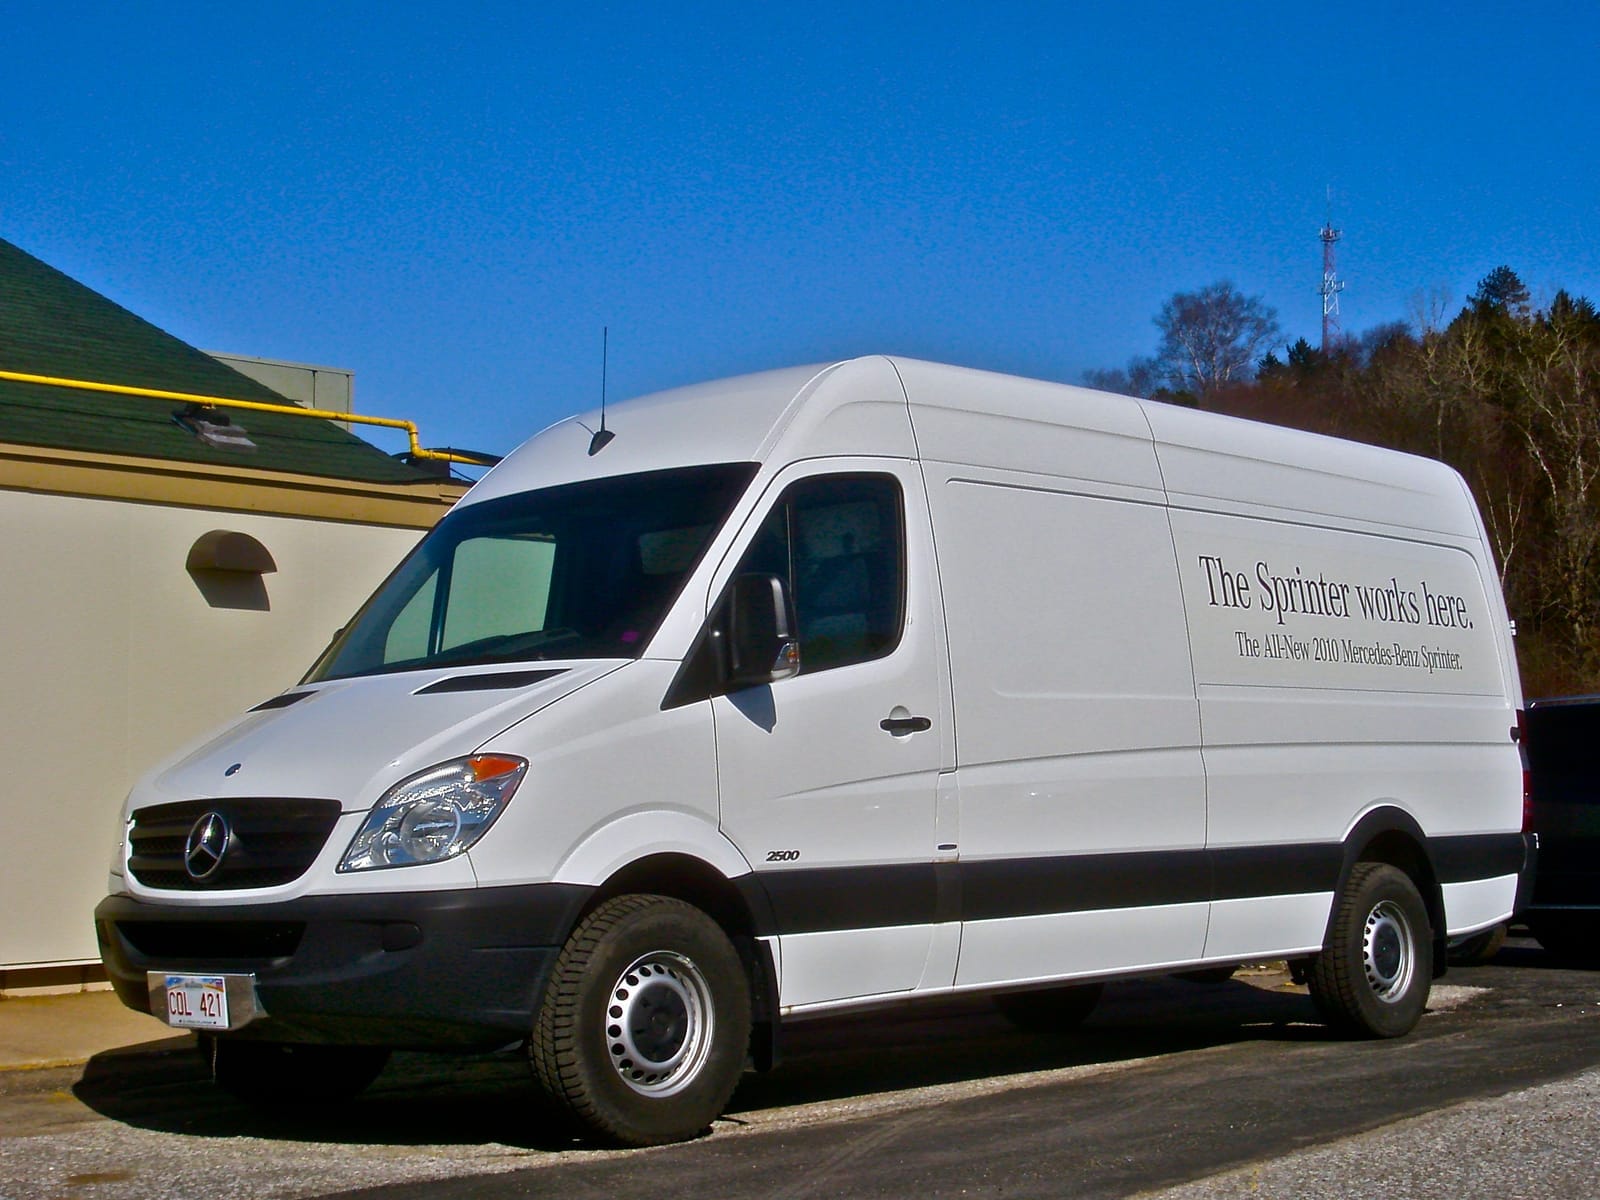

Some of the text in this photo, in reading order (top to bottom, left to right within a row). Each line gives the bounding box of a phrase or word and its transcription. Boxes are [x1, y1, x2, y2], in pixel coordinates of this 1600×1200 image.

[1199, 556, 1474, 629] The Sprinter works here.
[1235, 631, 1463, 674] The All-New 2010 Mercedes-Benz Sprinter.
[766, 850, 800, 861] 2500
[200, 992, 222, 1017] 421
